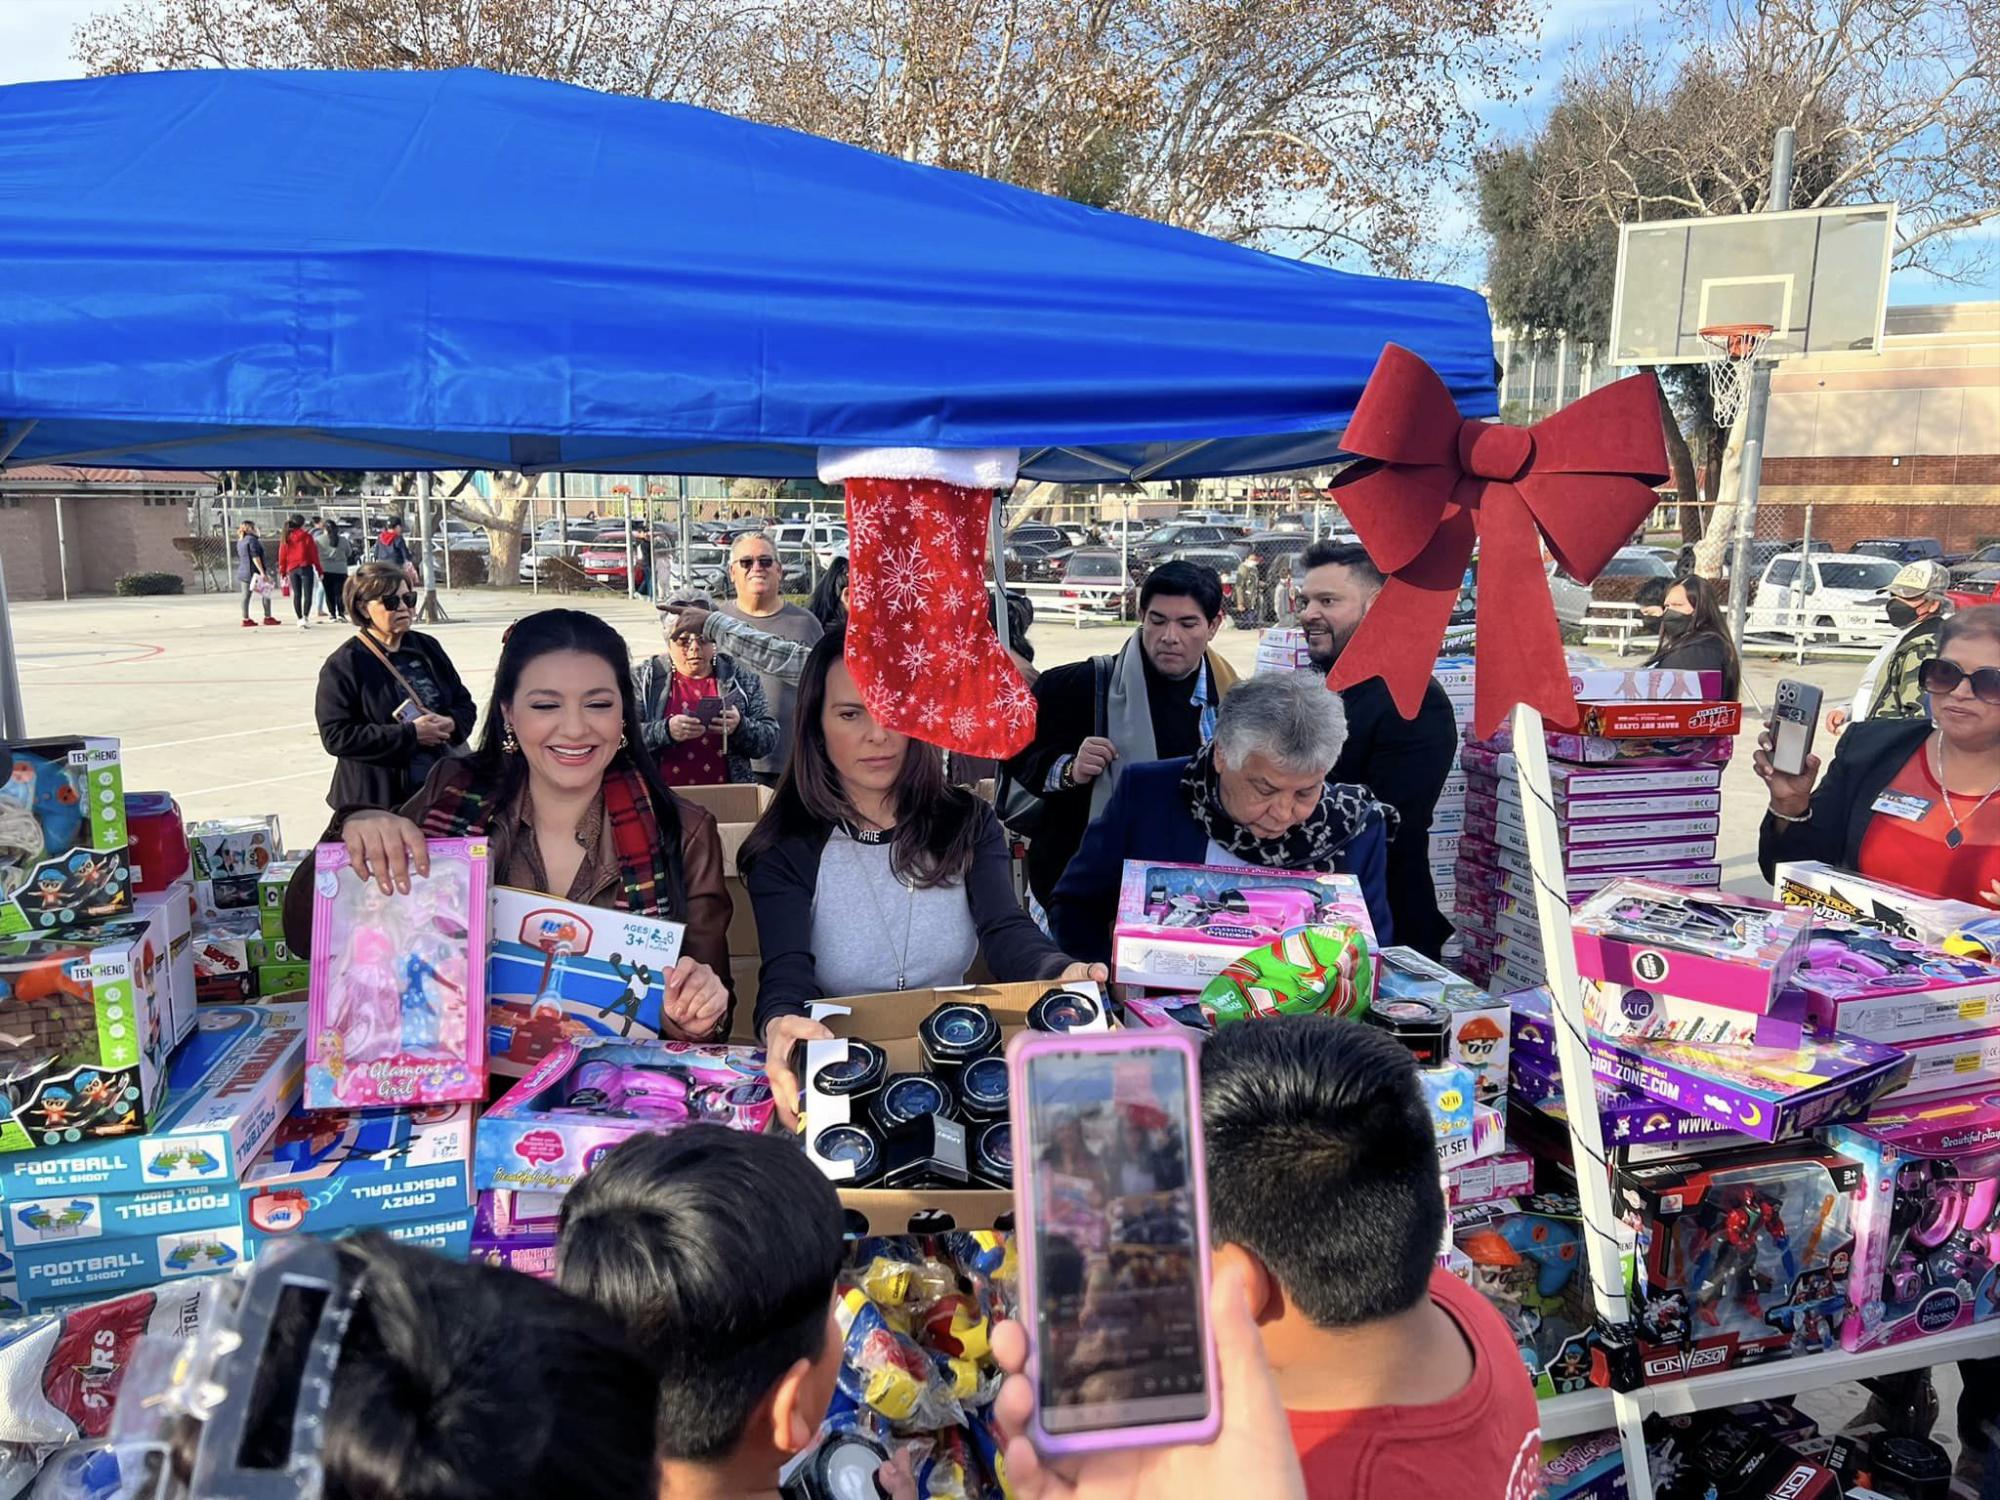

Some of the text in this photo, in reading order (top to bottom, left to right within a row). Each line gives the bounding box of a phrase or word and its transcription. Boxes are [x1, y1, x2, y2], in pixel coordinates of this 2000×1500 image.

[858, 829, 881, 843] KATE
[623, 923, 649, 935] AGES
[625, 933, 644, 946] 3+
[1623, 1003, 1649, 1016] DIY
[1620, 1055, 1634, 1067] Life
[1440, 1095, 1460, 1107] NEW
[1450, 1137, 1468, 1155] SET
[14, 1155, 128, 1176] FOOTBALL
[36, 1171, 110, 1186] BALL SHOOT
[351, 1175, 458, 1199] BASKETBALL
[134, 1185, 209, 1202] BALL SHOOT
[381, 1191, 436, 1210] CRAZY
[115, 1193, 230, 1220] FOOTBALL
[390, 1219, 468, 1240] BASKETB
[29, 1252, 145, 1280] FOOTBALL
[51, 1269, 126, 1287] BALL SHOOT
[183, 1291, 201, 1337] TBALL
[1922, 1308, 1956, 1327] Princess
